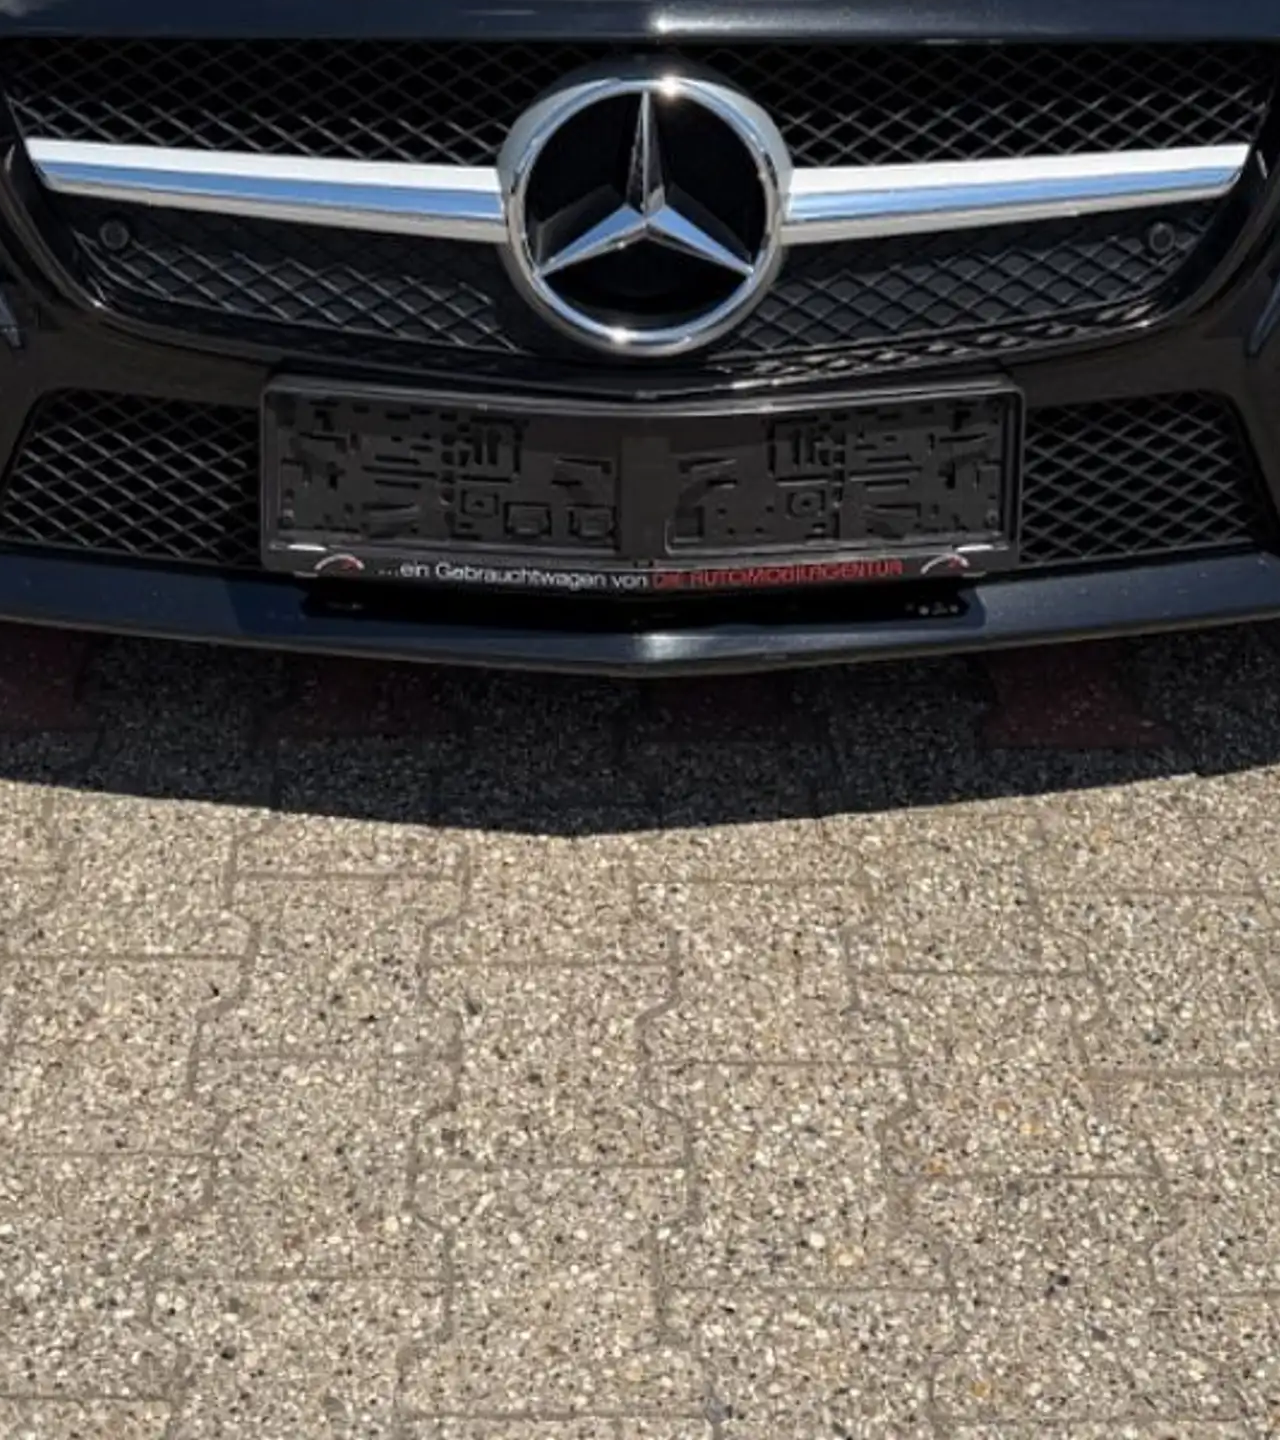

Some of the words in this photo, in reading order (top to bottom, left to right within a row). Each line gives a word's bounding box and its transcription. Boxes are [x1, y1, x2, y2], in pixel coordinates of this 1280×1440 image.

[435, 561, 607, 591] Gebrauchtwagen
[611, 574, 648, 589] von
[690, 558, 903, 587] AUTOMOBILAGENTUR
